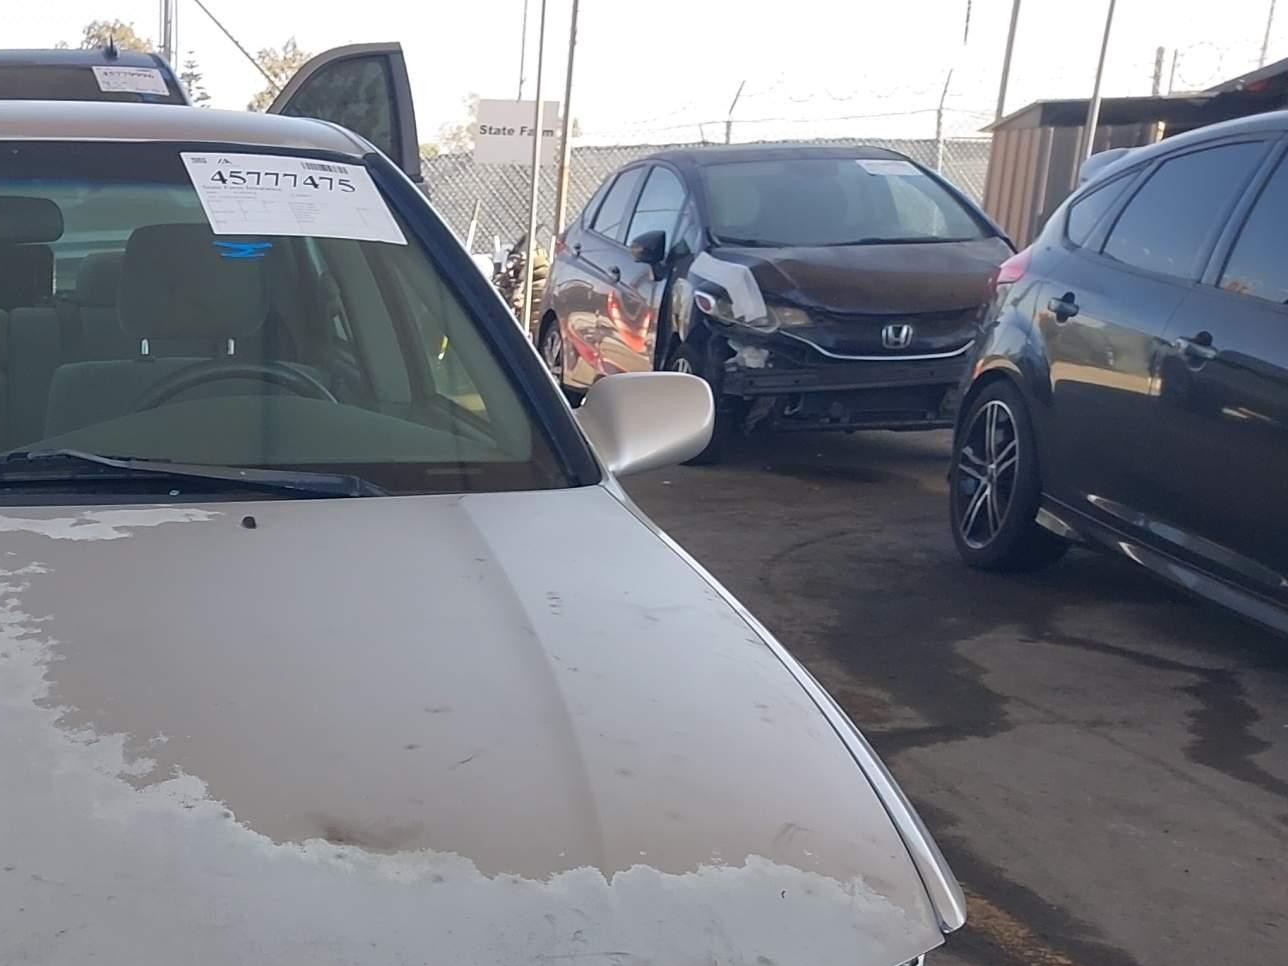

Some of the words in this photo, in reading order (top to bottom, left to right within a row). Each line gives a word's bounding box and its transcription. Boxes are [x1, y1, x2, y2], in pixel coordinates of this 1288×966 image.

[479, 125, 515, 136] State
[519, 126, 554, 137] Fam
[210, 169, 356, 193] 45777475
